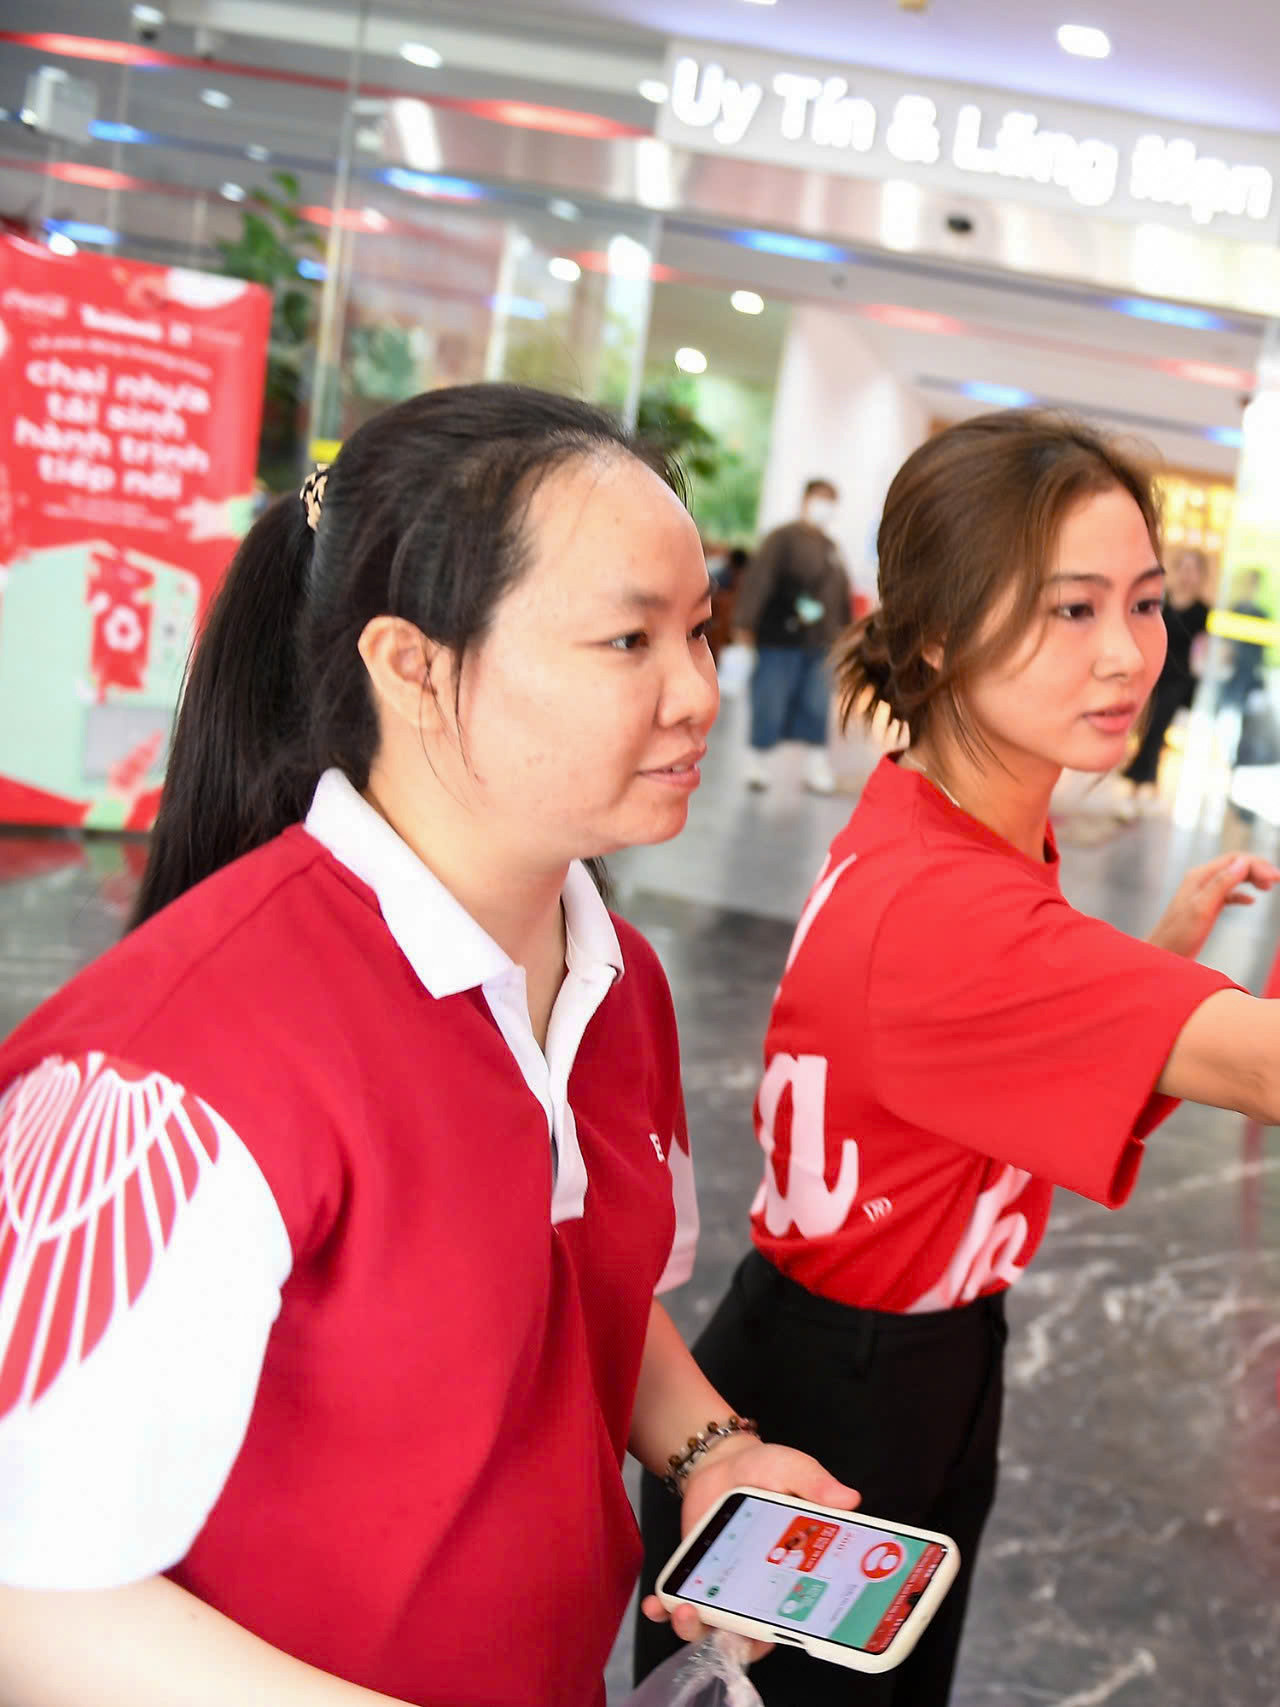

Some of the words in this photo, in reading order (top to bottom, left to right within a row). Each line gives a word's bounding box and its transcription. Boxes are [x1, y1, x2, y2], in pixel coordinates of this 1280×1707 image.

[671, 57, 763, 145] Uy
[887, 94, 939, 163] &
[26, 357, 109, 397] chai
[106, 404, 188, 440] sinh
